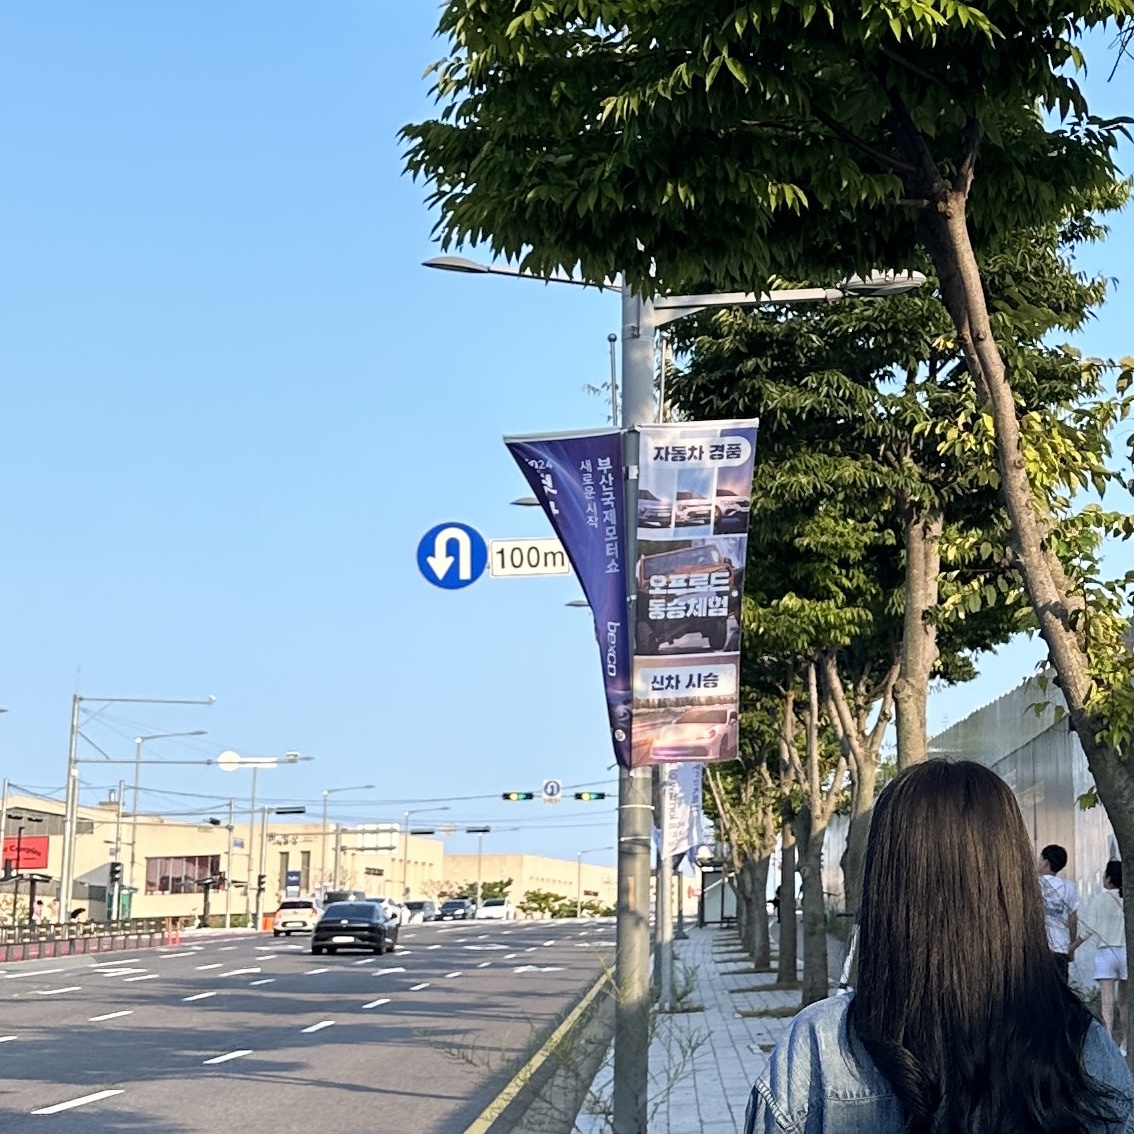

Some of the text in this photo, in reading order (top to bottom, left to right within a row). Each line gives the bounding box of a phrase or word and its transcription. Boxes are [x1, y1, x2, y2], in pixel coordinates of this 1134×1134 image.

[653, 443, 742, 462] 자동차 경품
[580, 459, 599, 529] 새로운 시작
[597, 456, 620, 574] 부산국제모터쇼
[496, 546, 565, 569] 100m
[649, 571, 730, 596] 오프로드
[648, 595, 729, 620] 동승체험
[607, 621, 621, 677] bexco
[651, 672, 719, 691] 신차 시승
